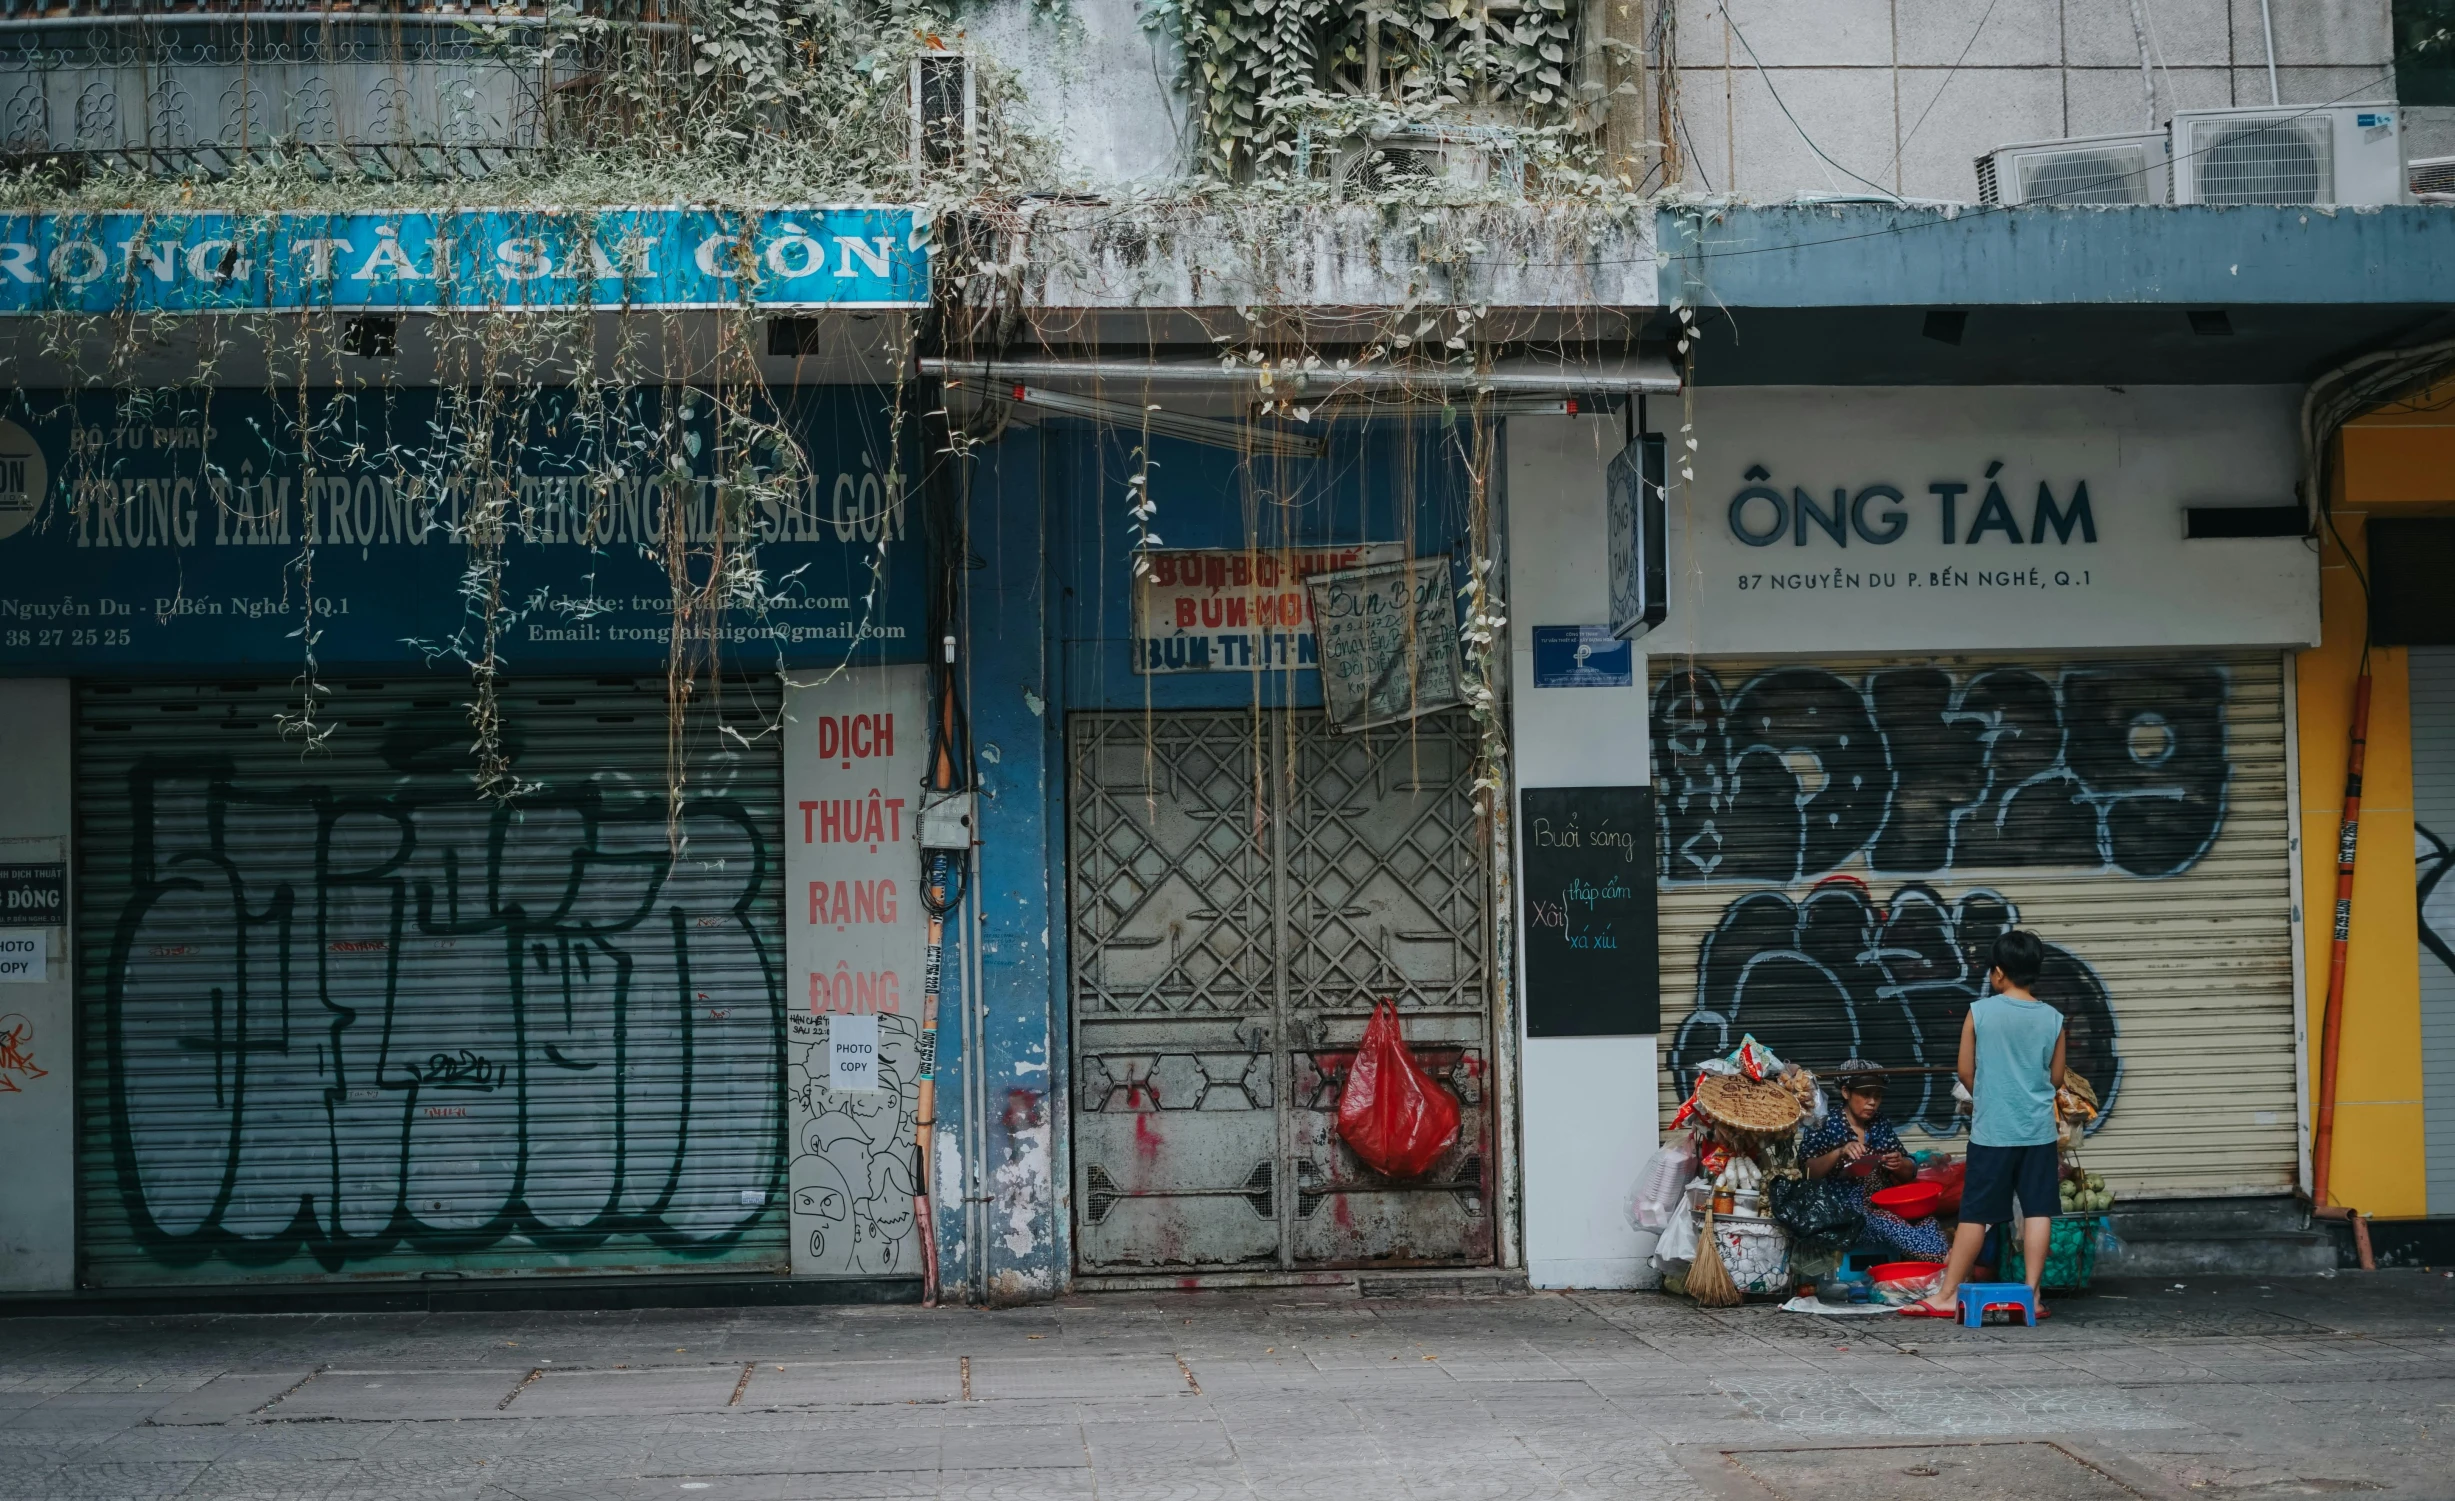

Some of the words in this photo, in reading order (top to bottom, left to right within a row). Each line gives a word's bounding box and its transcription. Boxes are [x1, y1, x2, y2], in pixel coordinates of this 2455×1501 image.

[292, 225, 458, 280] TÀI
[695, 222, 895, 278] GÒN
[70, 422, 104, 450] BỘ
[153, 420, 218, 449] PHÁP
[73, 476, 199, 548] TRUNG
[210, 457, 291, 546] TÂM
[306, 474, 428, 562] TRỌNG
[833, 450, 908, 543] GÒN
[1728, 464, 1909, 548] ÔNG
[1929, 461, 2098, 546] TÁM
[1613, 502, 1629, 538] ÔNG
[1613, 541, 1629, 581] TÁM
[1738, 574, 1763, 590] 87
[1771, 567, 1860, 589] NGUYỄN
[1869, 573, 1896, 588] DU
[1908, 572, 1922, 588] P.
[1929, 566, 1973, 587] BẾN
[1979, 567, 2046, 589] NGHÉ,
[1, 596, 91, 620] Nguyễn
[99, 599, 132, 616] Du
[314, 597, 350, 617] Q.1
[528, 594, 624, 613] Website:
[631, 594, 850, 613] trongtaisaigon.com
[5, 629, 31, 647] 38
[38, 629, 64, 647] 27
[71, 629, 99, 647] 25
[104, 628, 131, 647] 25
[528, 624, 601, 642] Email:
[608, 621, 906, 643] trongtaisaigon@gmail.com
[818, 713, 894, 769] DỊCH
[799, 787, 905, 854] THUẬT
[1532, 811, 1581, 848] Buổi
[1590, 818, 1636, 863] sáng
[11, 869, 32, 880] DỊCH
[34, 867, 62, 880] THUẬT
[7, 884, 61, 909] ĐÔNG
[809, 879, 897, 933] RẠNG
[1567, 877, 1599, 912] thập
[1601, 875, 1632, 899] cẩm
[1531, 900, 1564, 928] Xôi
[1569, 924, 1589, 950] xá
[1593, 922, 1618, 950] xíu
[809, 960, 900, 1016] ĐÔNG
[836, 1044, 872, 1054] PHOTO
[840, 1062, 868, 1073] COPY
